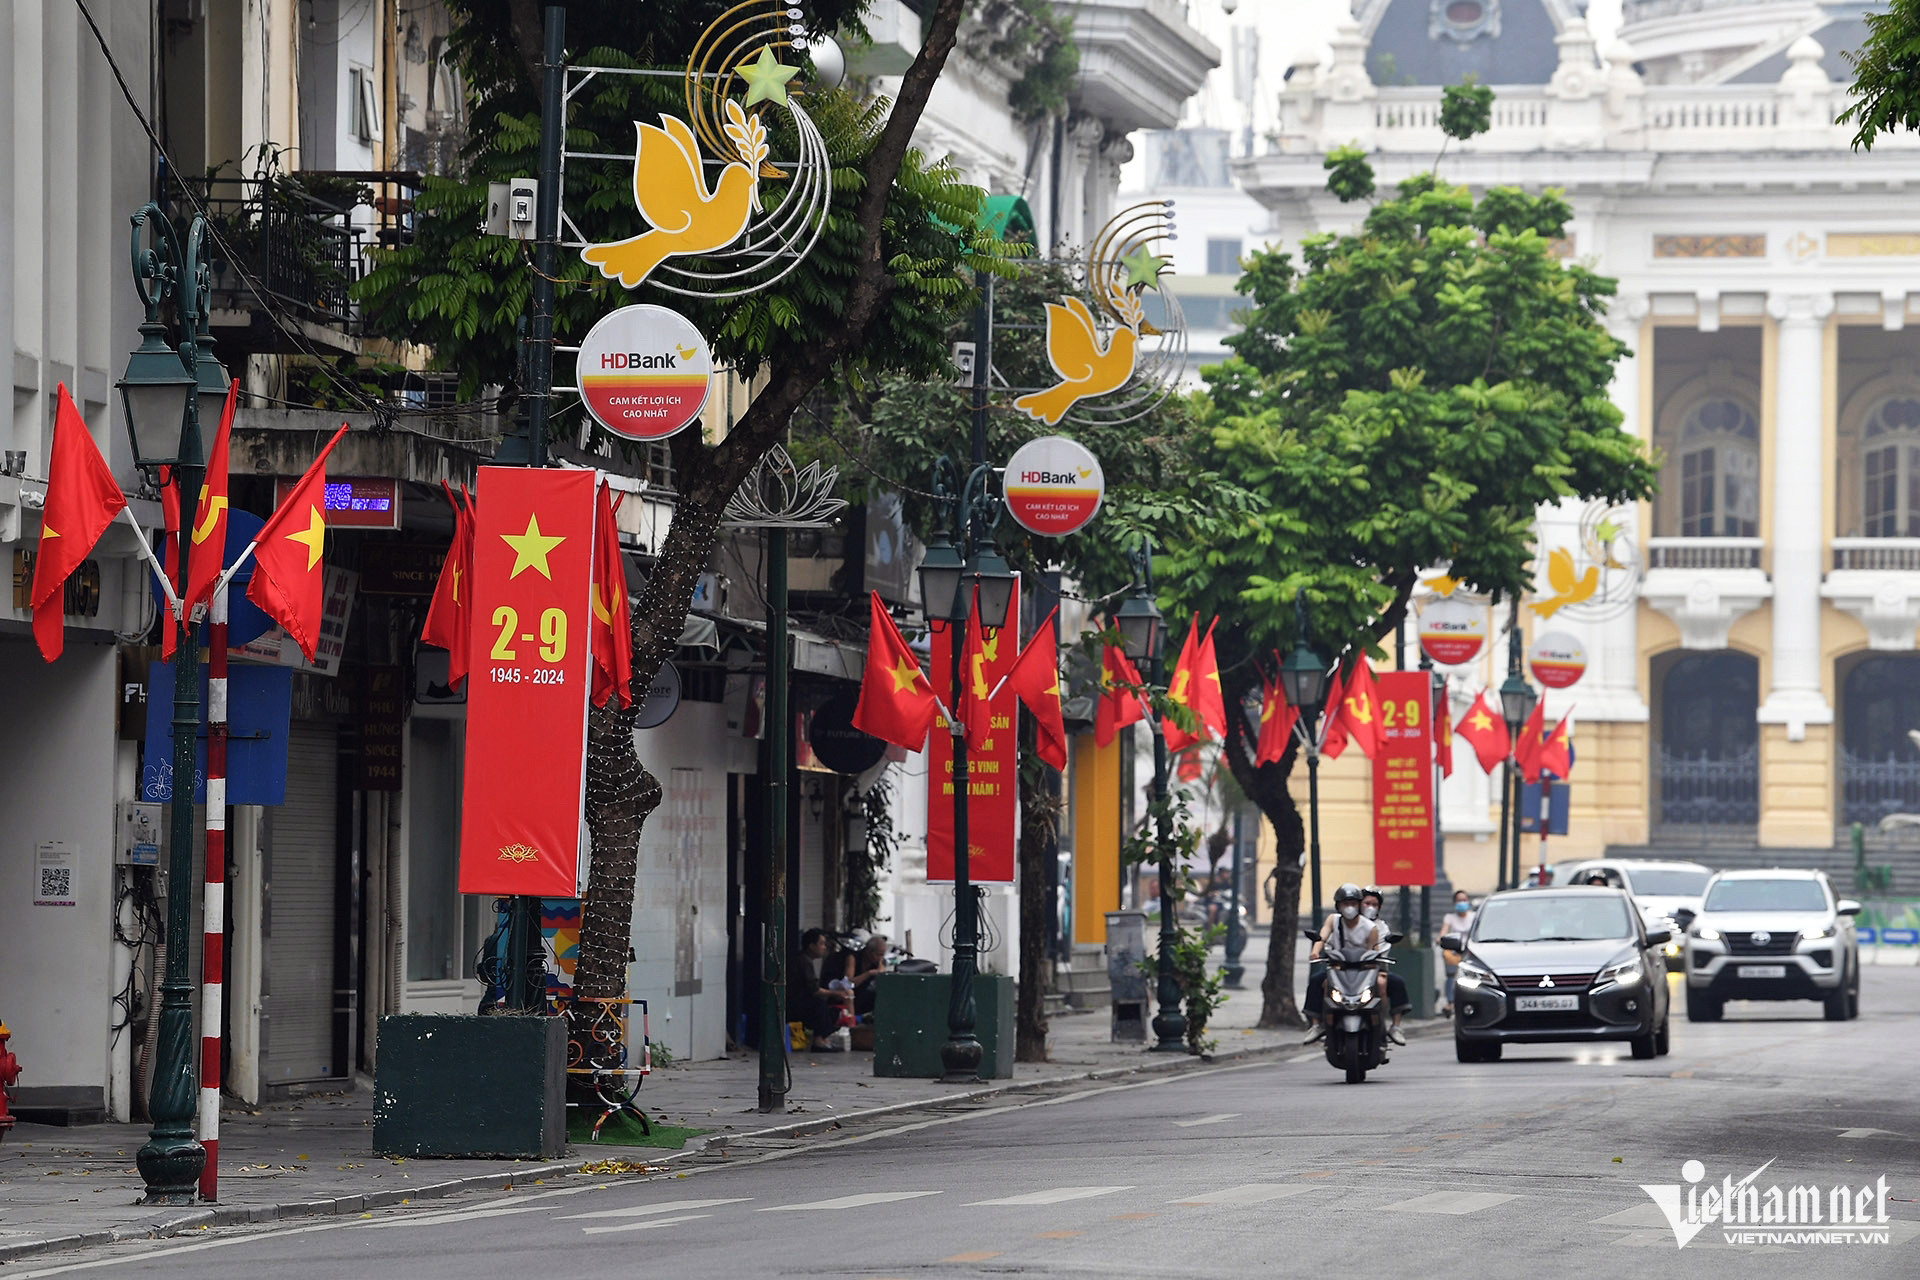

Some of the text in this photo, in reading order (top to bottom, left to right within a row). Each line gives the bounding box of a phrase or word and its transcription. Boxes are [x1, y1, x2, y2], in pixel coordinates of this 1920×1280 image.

[601, 353, 676, 368] HDBank
[609, 394, 681, 407] CAM KẾT LỢI ÍCH
[623, 407, 668, 418] CAO NHẤT
[1021, 471, 1076, 484] HDBank
[491, 605, 568, 663] 2-9
[490, 667, 521, 683] 1945
[533, 669, 564, 684] 2024
[991, 712, 1010, 729] SẢN
[365, 745, 399, 757] SINCE
[368, 766, 396, 777] 1944
[978, 760, 999, 773] VINH
